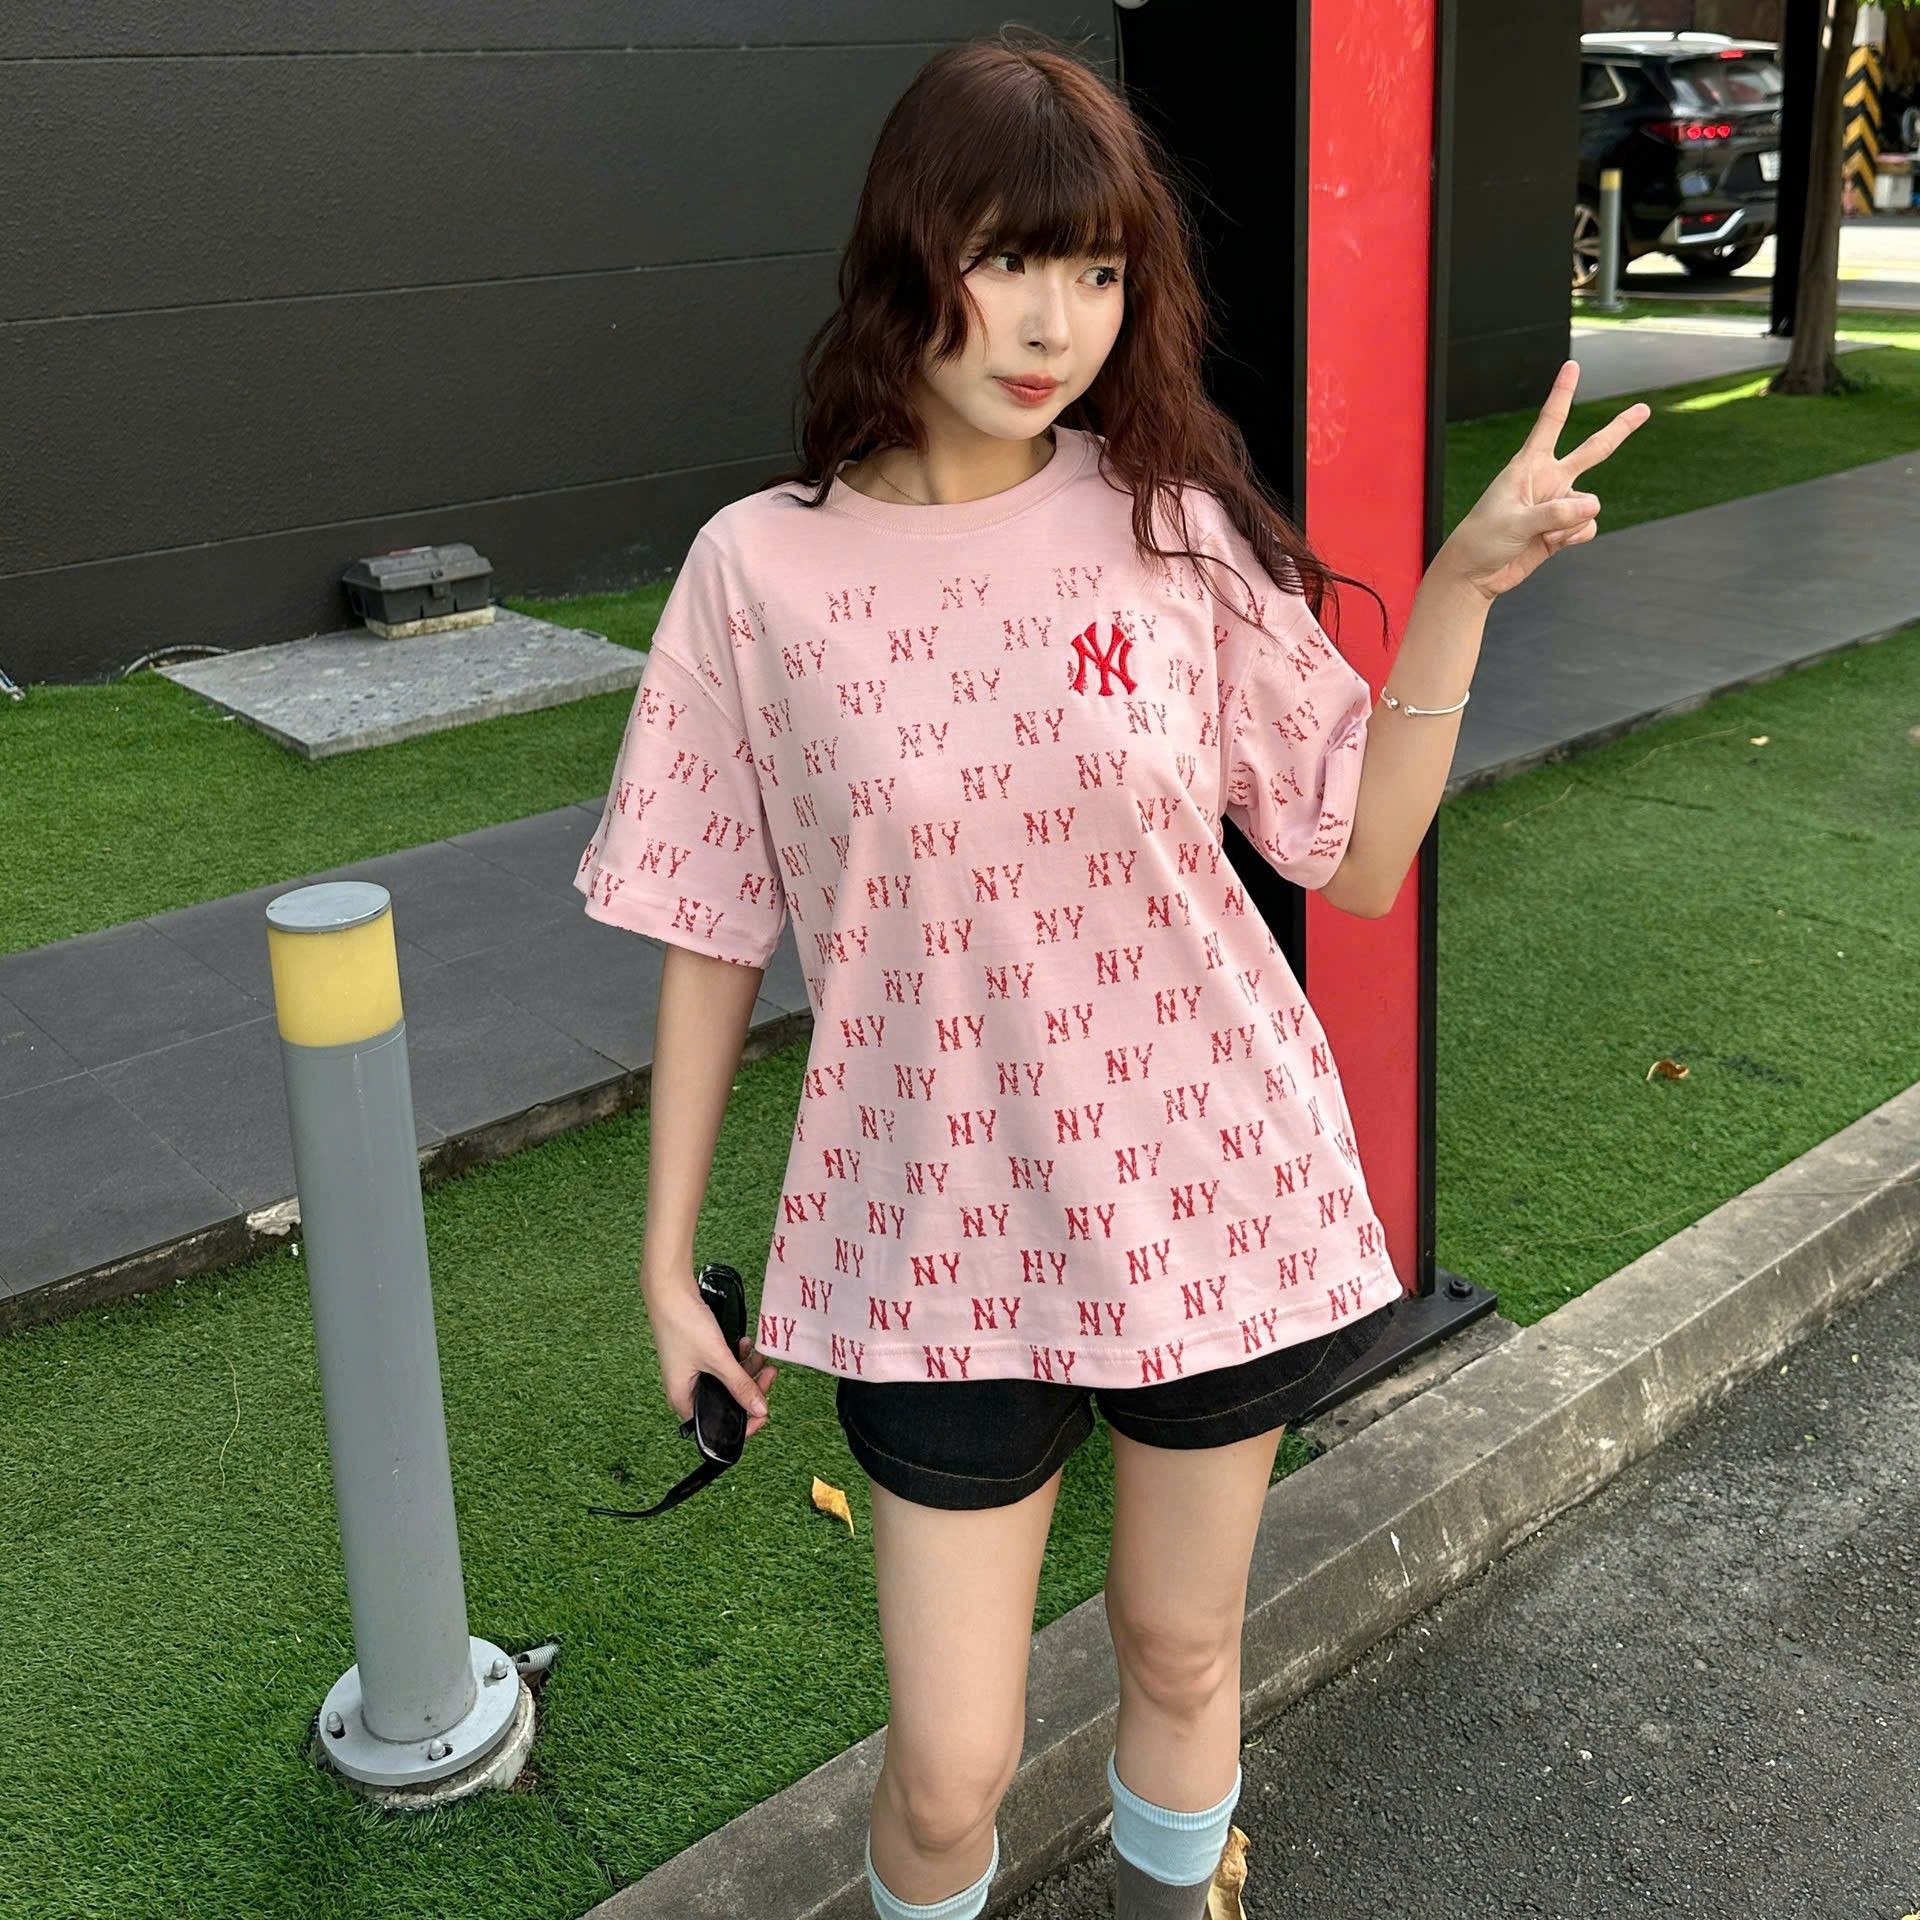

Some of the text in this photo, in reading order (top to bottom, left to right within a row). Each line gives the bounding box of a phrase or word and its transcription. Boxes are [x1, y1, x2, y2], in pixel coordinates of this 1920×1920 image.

[782, 639, 826, 680] NY
[888, 625, 938, 664] NY
[1070, 621, 1138, 696] NY
[951, 668, 1000, 703] NY
[1014, 705, 1063, 746] NY
[668, 751, 717, 792] NY
[962, 765, 1011, 800] NY
[1076, 751, 1127, 788] NY
[617, 781, 657, 820] NY
[848, 777, 895, 817] NY
[702, 811, 755, 852] NY
[911, 822, 958, 858] NY
[1023, 807, 1075, 843] NY
[637, 839, 691, 879] NY
[1086, 851, 1137, 888] NY
[867, 876, 910, 908] NY
[974, 864, 1023, 901] NY
[924, 919, 972, 955] NY
[1034, 905, 1083, 944] NY
[986, 963, 1033, 997] NY
[1095, 946, 1143, 983] NY
[1046, 1004, 1092, 1044] NY
[1155, 986, 1201, 1024] NY
[840, 1016, 884, 1047] NY
[936, 1016, 984, 1052] NY
[1209, 1023, 1255, 1065] NY
[895, 1065, 935, 1099] NY
[998, 1062, 1044, 1096] NY
[1105, 1045, 1152, 1084] NY
[1163, 1082, 1210, 1124] NY
[859, 1104, 896, 1143] NY
[948, 1110, 996, 1148] NY
[1055, 1103, 1104, 1144] NY
[1219, 1120, 1263, 1161] NY
[823, 1146, 861, 1183] NY
[907, 1162, 948, 1193] NY
[1008, 1156, 1055, 1192] NY
[1114, 1143, 1161, 1184] NY
[1274, 1153, 1312, 1197] NY
[783, 1193, 826, 1224] NY
[867, 1200, 904, 1237] NY
[1171, 1180, 1219, 1221] NY
[1318, 1185, 1354, 1229] NY
[961, 1204, 1008, 1237] NY
[1065, 1203, 1115, 1240] NY
[1227, 1216, 1271, 1258] NY
[835, 1239, 863, 1276] NY
[911, 1253, 960, 1286] NY
[1021, 1249, 1066, 1284] NY
[1125, 1239, 1169, 1285] NY
[1278, 1248, 1317, 1290] NY
[800, 1276, 831, 1312] NY
[869, 1296, 912, 1330] NY
[1181, 1275, 1227, 1319] NY
[1327, 1276, 1363, 1322] NY
[761, 1314, 797, 1351] NY
[971, 1296, 1020, 1331] NY
[1078, 1301, 1126, 1336] NY
[1239, 1307, 1279, 1354] NY
[831, 1335, 864, 1375] NY
[923, 1345, 971, 1380] NY
[1031, 1346, 1077, 1384] NY
[1136, 1338, 1185, 1384] NY
